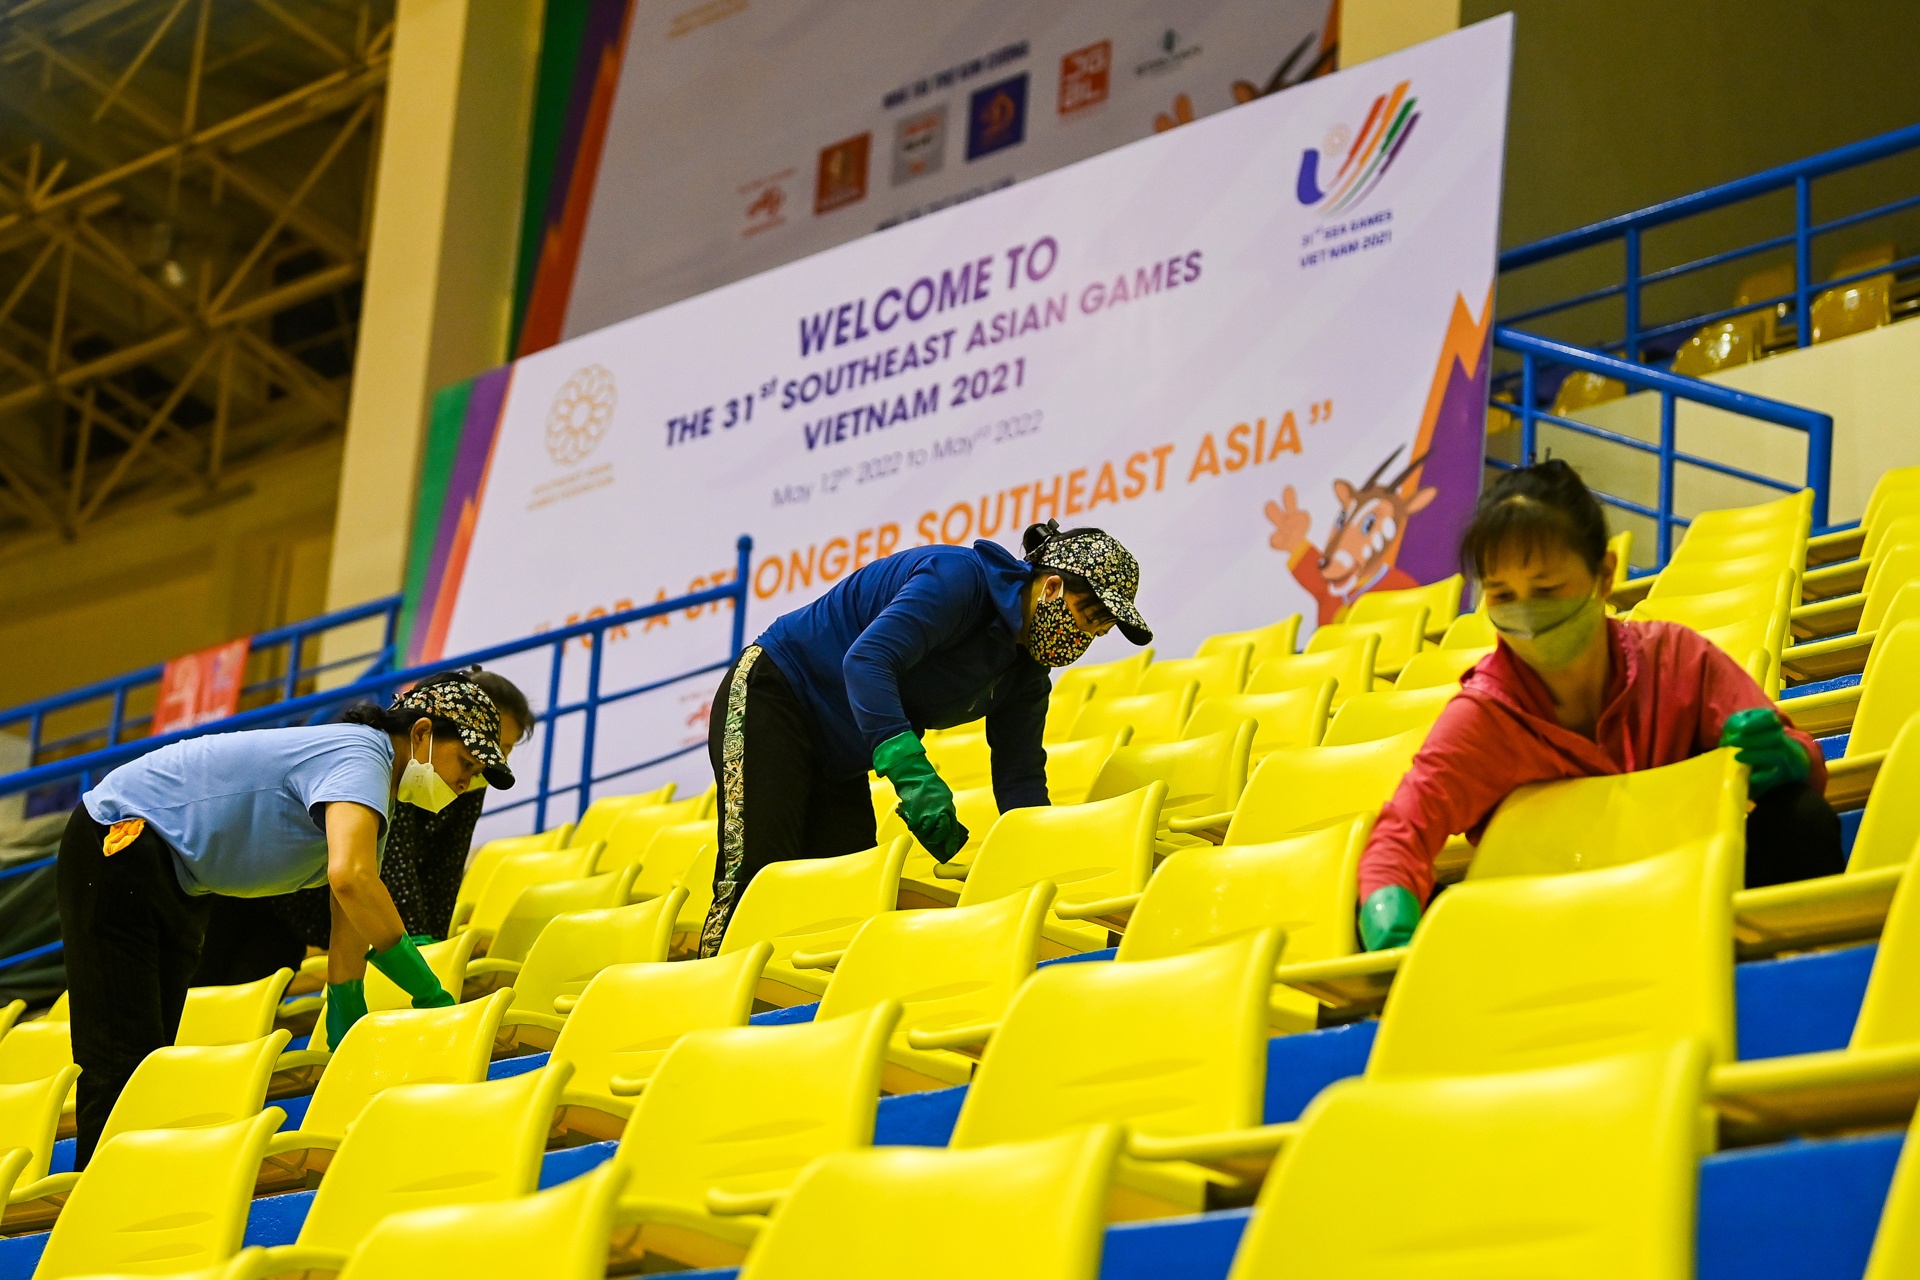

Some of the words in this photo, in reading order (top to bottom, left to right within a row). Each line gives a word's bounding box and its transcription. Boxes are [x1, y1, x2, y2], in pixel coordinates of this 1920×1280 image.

[1330, 240, 1359, 259] NAM
[1362, 229, 1393, 250] 2021
[1349, 209, 1393, 231] GAMES
[799, 255, 994, 358] WELCOME
[1005, 234, 1059, 290] TO
[666, 404, 714, 447] THE
[780, 327, 958, 411] SOUTHEAST
[965, 292, 1069, 354] ASIAN
[1079, 248, 1204, 315] GAMES
[802, 383, 941, 451] VIETNAM
[949, 356, 1027, 409] 2021
[770, 483, 815, 507] May
[855, 449, 904, 485] 2022
[906, 447, 929, 467] to
[993, 408, 1045, 443] 2022
[684, 521, 901, 620] STONGER
[915, 441, 1176, 547] SOUTHEAST
